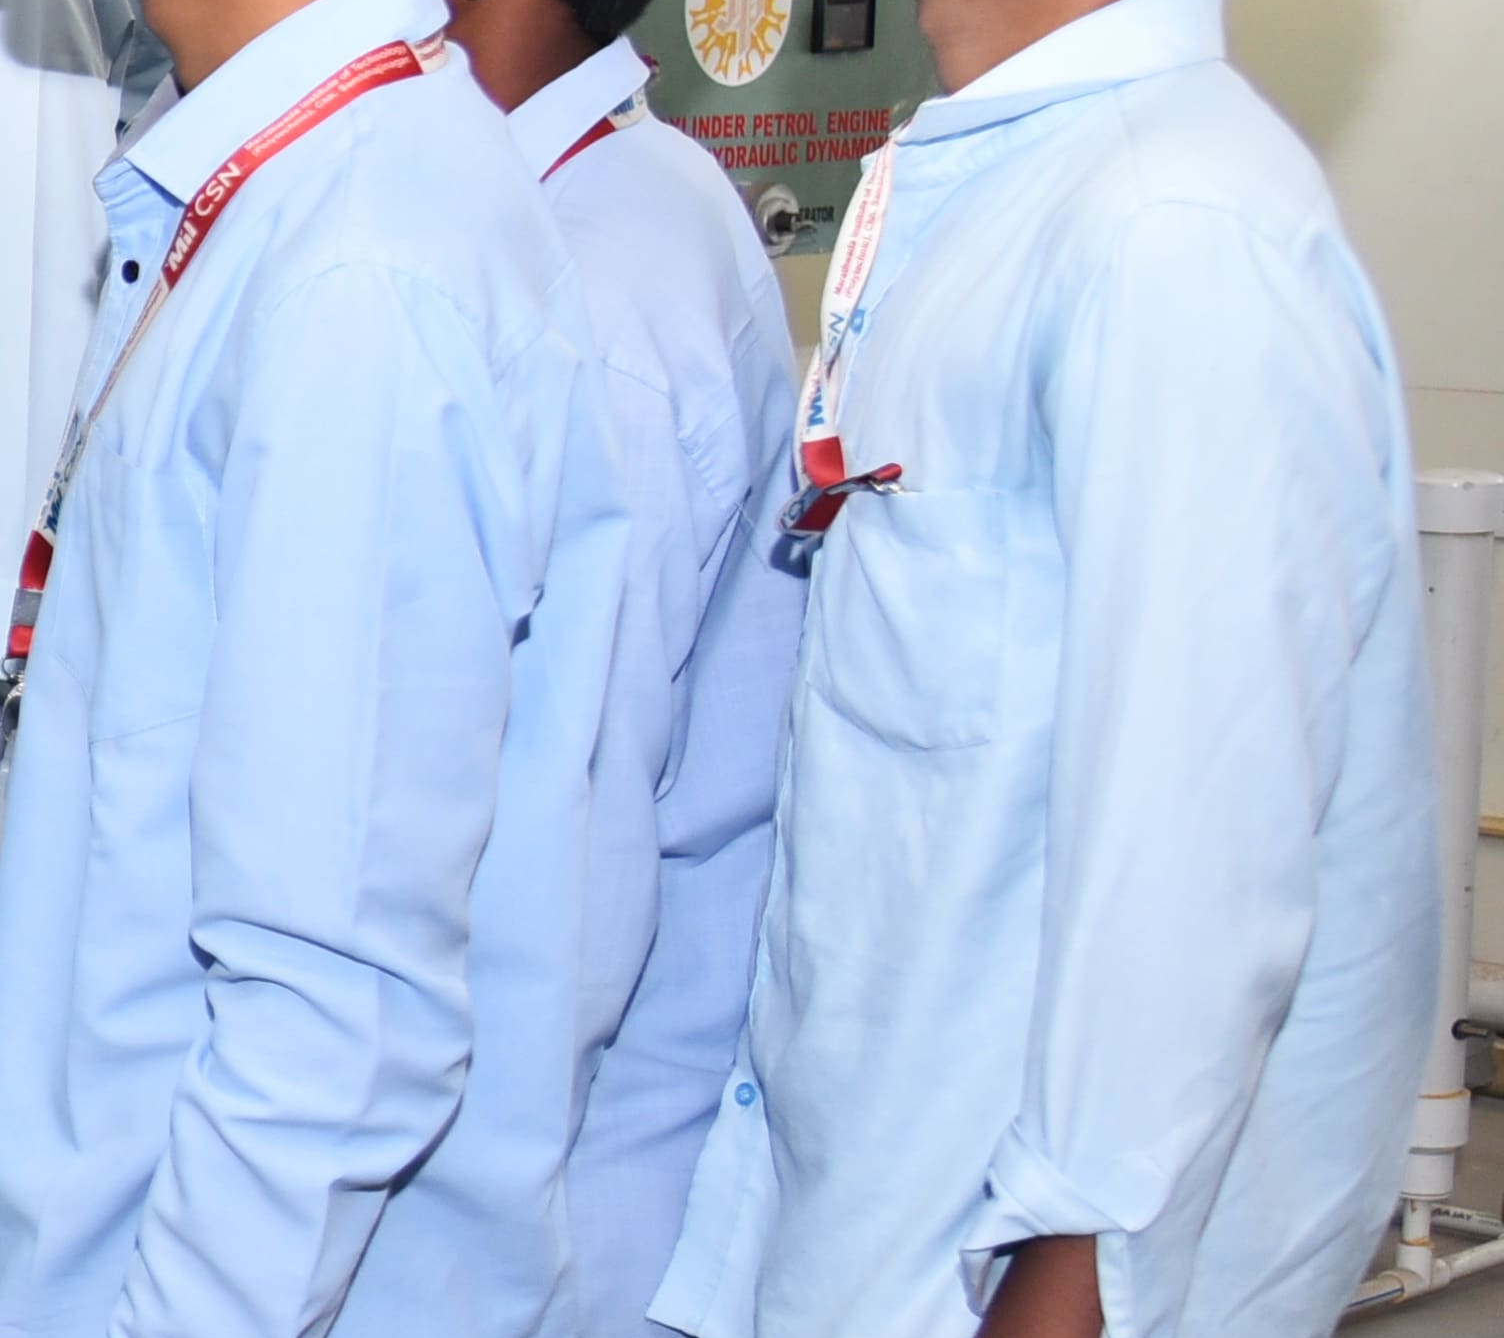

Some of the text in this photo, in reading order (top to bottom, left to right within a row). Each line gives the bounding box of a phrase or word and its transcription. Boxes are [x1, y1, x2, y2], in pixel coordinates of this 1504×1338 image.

[753, 112, 817, 137] PETROL
[827, 108, 890, 134] ENGINE
[194, 161, 242, 217] CSN
